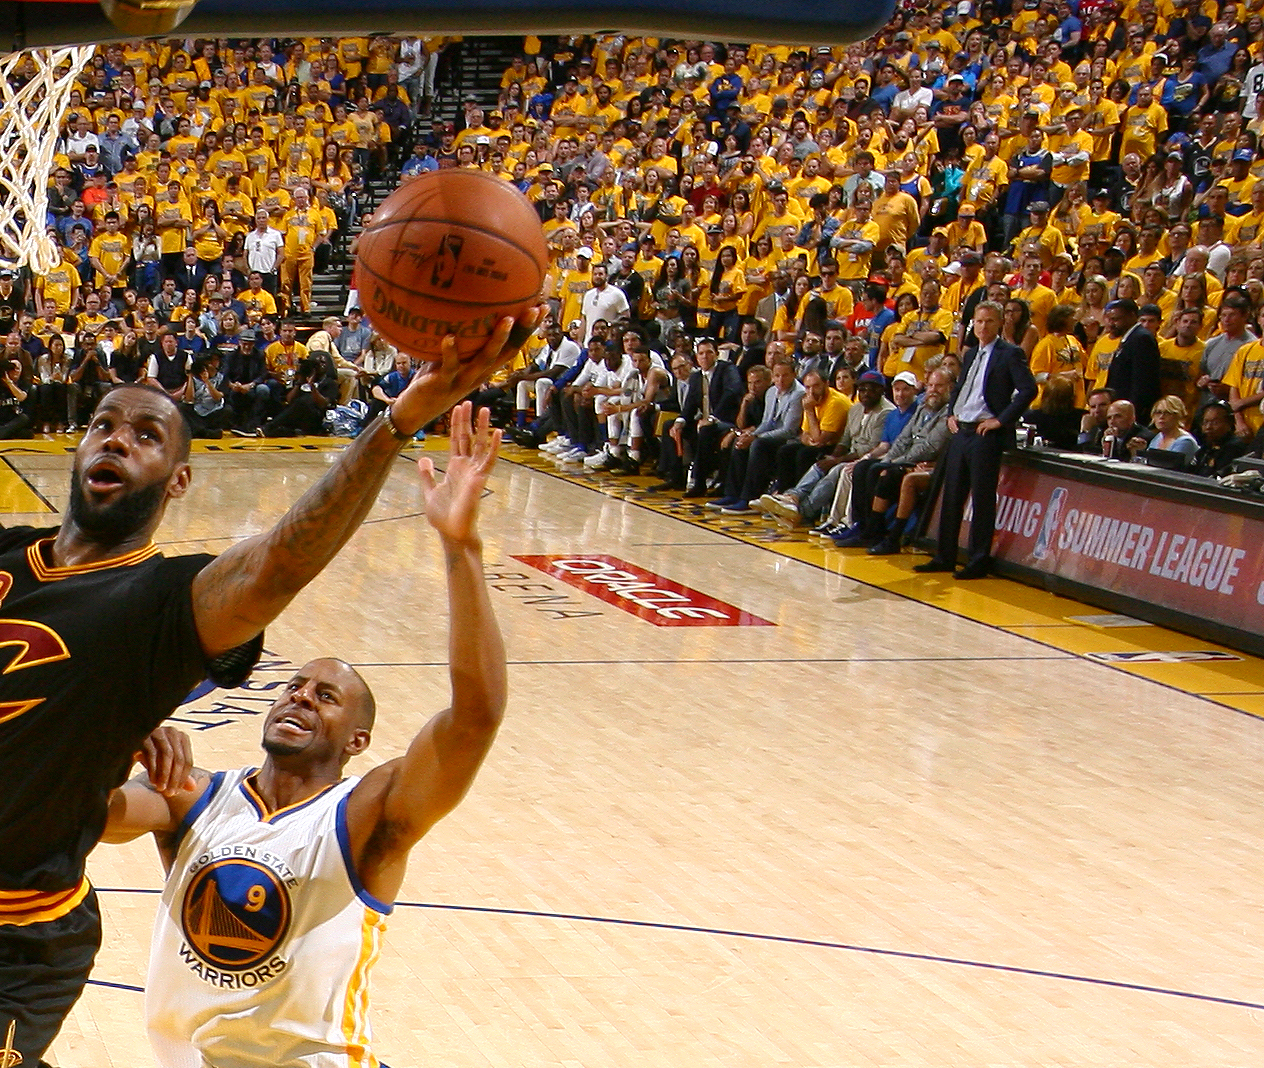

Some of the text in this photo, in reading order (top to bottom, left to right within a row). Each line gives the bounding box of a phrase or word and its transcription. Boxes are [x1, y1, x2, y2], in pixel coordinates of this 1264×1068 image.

[372, 285, 499, 338] SPALDING
[1058, 507, 1156, 571] SUMMER
[1150, 530, 1246, 595] LEAGUE
[484, 562, 604, 620] RENA
[551, 559, 731, 619] ORACLE
[189, 845, 299, 890] GOLDEN STATE
[243, 884, 267, 912] 9
[179, 942, 288, 989] WARRIORS
